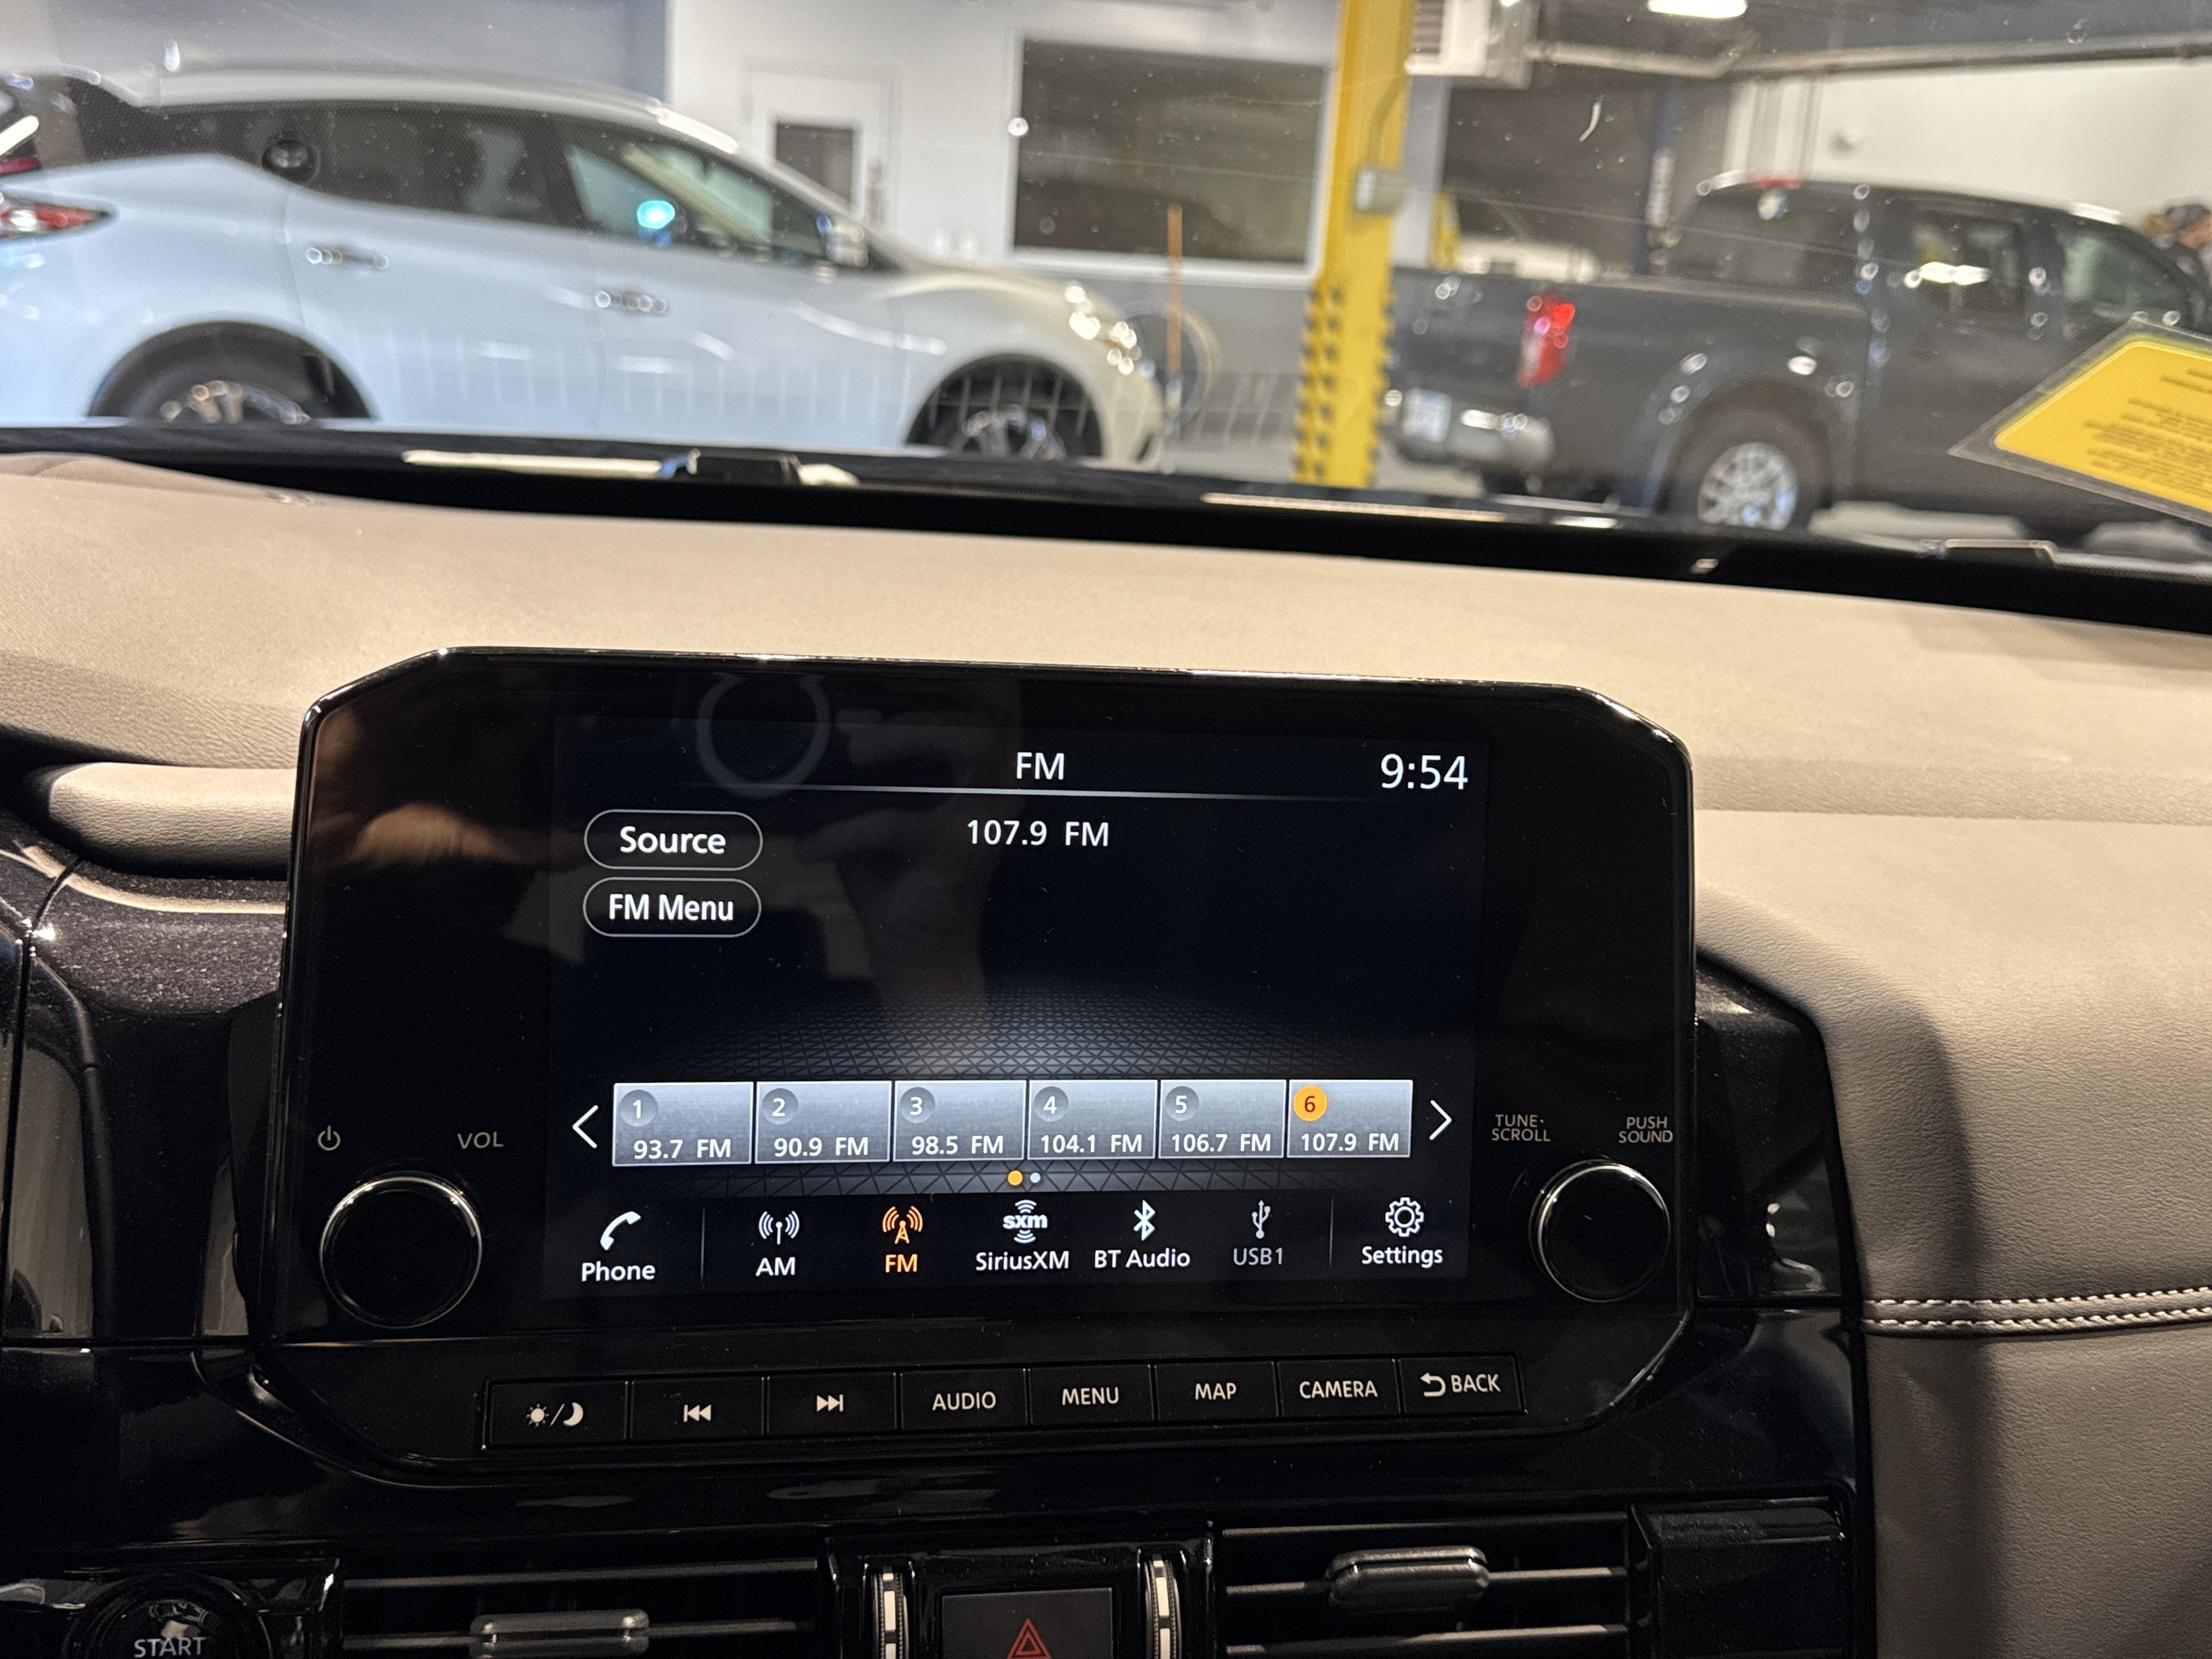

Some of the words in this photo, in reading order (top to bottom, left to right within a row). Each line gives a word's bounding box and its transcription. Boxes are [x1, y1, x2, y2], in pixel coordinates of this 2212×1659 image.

[1017, 752, 1064, 780] FM
[1381, 753, 1468, 790] 9:54
[620, 826, 726, 854] Source
[967, 820, 1047, 845] 107.9
[1065, 821, 1109, 847] FM
[610, 894, 650, 920] FM
[659, 894, 733, 921] Menu
[632, 1100, 643, 1120] 1
[771, 1098, 786, 1118] 2
[909, 1097, 924, 1116] 3
[1043, 1096, 1057, 1115] 4
[1175, 1096, 1188, 1114] 5
[1304, 1096, 1316, 1113] 6
[1627, 1116, 1667, 1129] PUSH
[458, 1131, 503, 1149] VOL
[1041, 1135, 1095, 1153] 104.1
[1111, 1134, 1142, 1153] FM
[1172, 1133, 1228, 1152] 106.7
[1240, 1133, 1271, 1152] FM
[1301, 1133, 1357, 1151] 107.9
[1368, 1133, 1398, 1151] FM
[1491, 1128, 1551, 1142] SCROLL
[1618, 1130, 1673, 1143] SOUND
[634, 1139, 683, 1159] 93.7
[696, 1139, 731, 1159] FM
[774, 1137, 822, 1157] 90.9
[836, 1137, 868, 1155] FM
[912, 1136, 958, 1155] 98.5
[972, 1135, 1003, 1154] FM
[1002, 1212, 1048, 1230] sxm
[885, 1254, 918, 1273] FM
[975, 1250, 1069, 1271] SiriusXM
[1094, 1249, 1121, 1268] BT
[1125, 1247, 1190, 1268] Audio
[1233, 1247, 1284, 1266] USB1
[1362, 1245, 1443, 1268] Settings
[582, 1261, 656, 1282] Phone
[755, 1256, 795, 1277] AM
[1195, 1383, 1237, 1400] MAP
[1300, 1380, 1378, 1399] CAMERA
[1451, 1374, 1500, 1392] BACK
[932, 1391, 996, 1410] AUDIO
[1062, 1386, 1119, 1406] MENU
[134, 1637, 206, 1658] START
